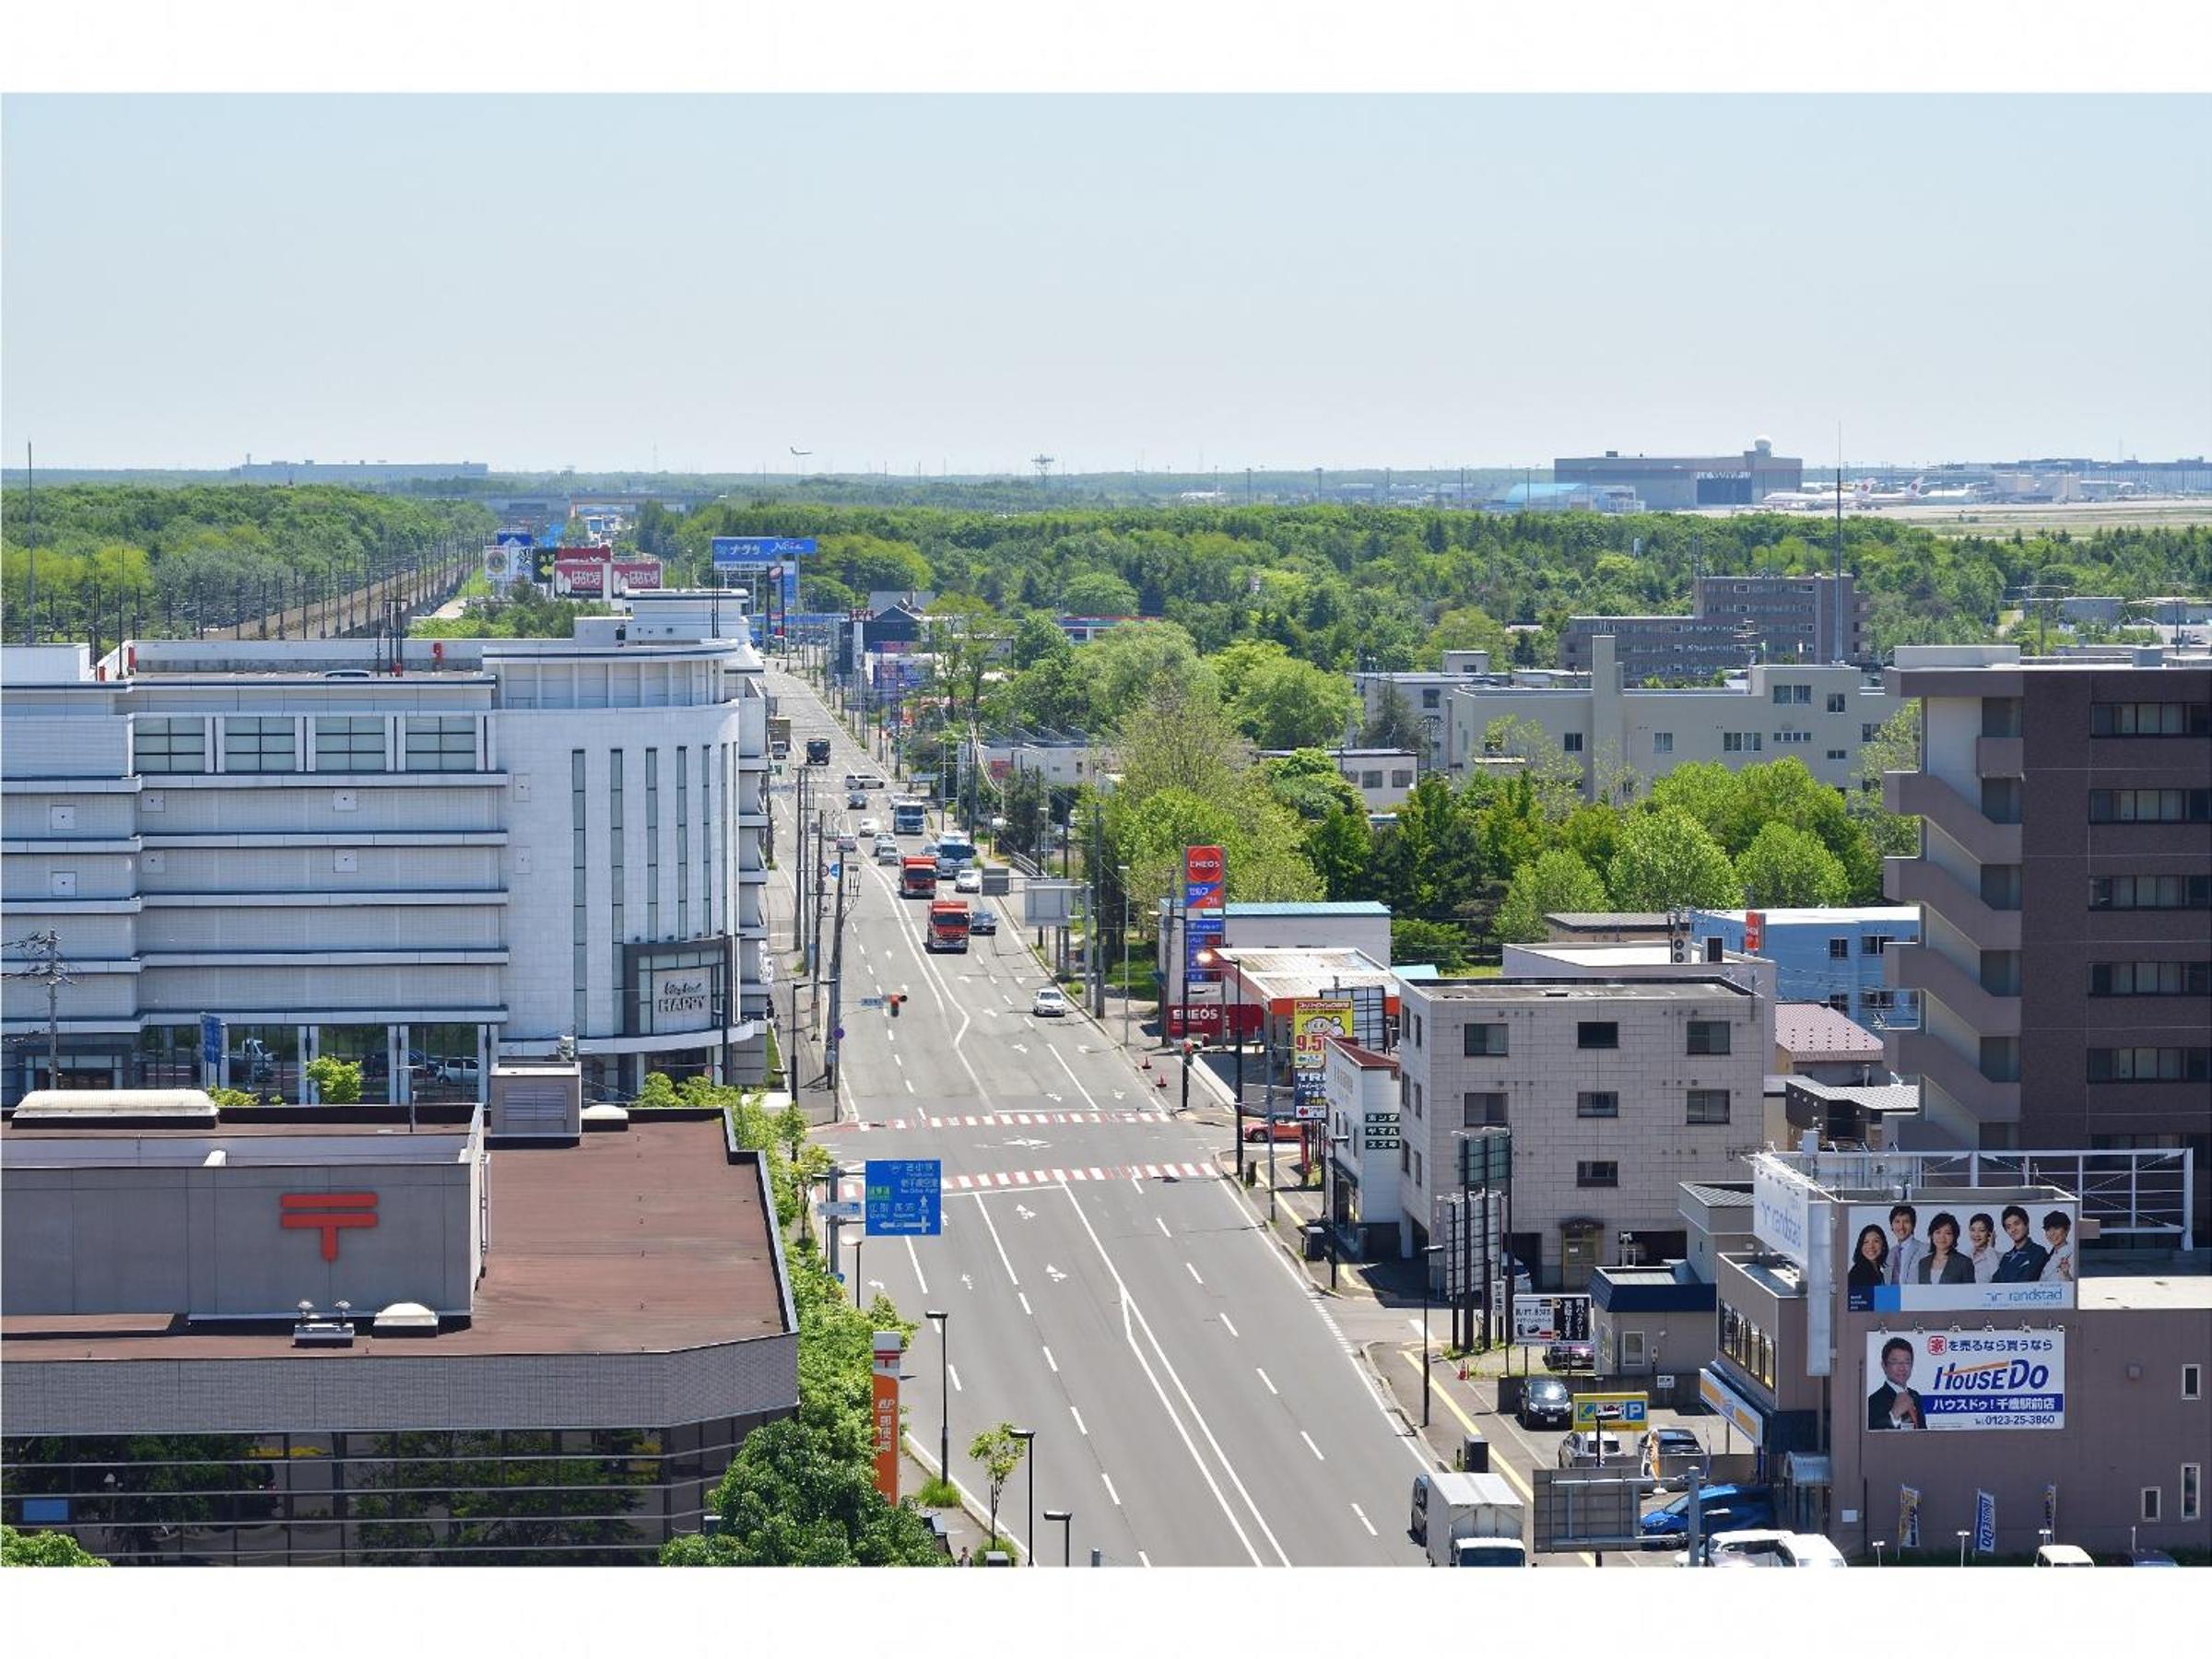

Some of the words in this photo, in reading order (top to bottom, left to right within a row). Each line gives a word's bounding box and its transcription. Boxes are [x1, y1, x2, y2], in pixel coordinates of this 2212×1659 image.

[1189, 860, 1220, 868] ENEOS
[658, 995, 706, 1012] HAPPY
[1368, 1127, 1397, 1135] ヤマハ
[2009, 1288, 2063, 1301] randstad
[1931, 1338, 2053, 1352] 家を売るなら買うなら
[1629, 1404, 1641, 1418] P
[1985, 1416, 2055, 1425] 0123-25-3860
